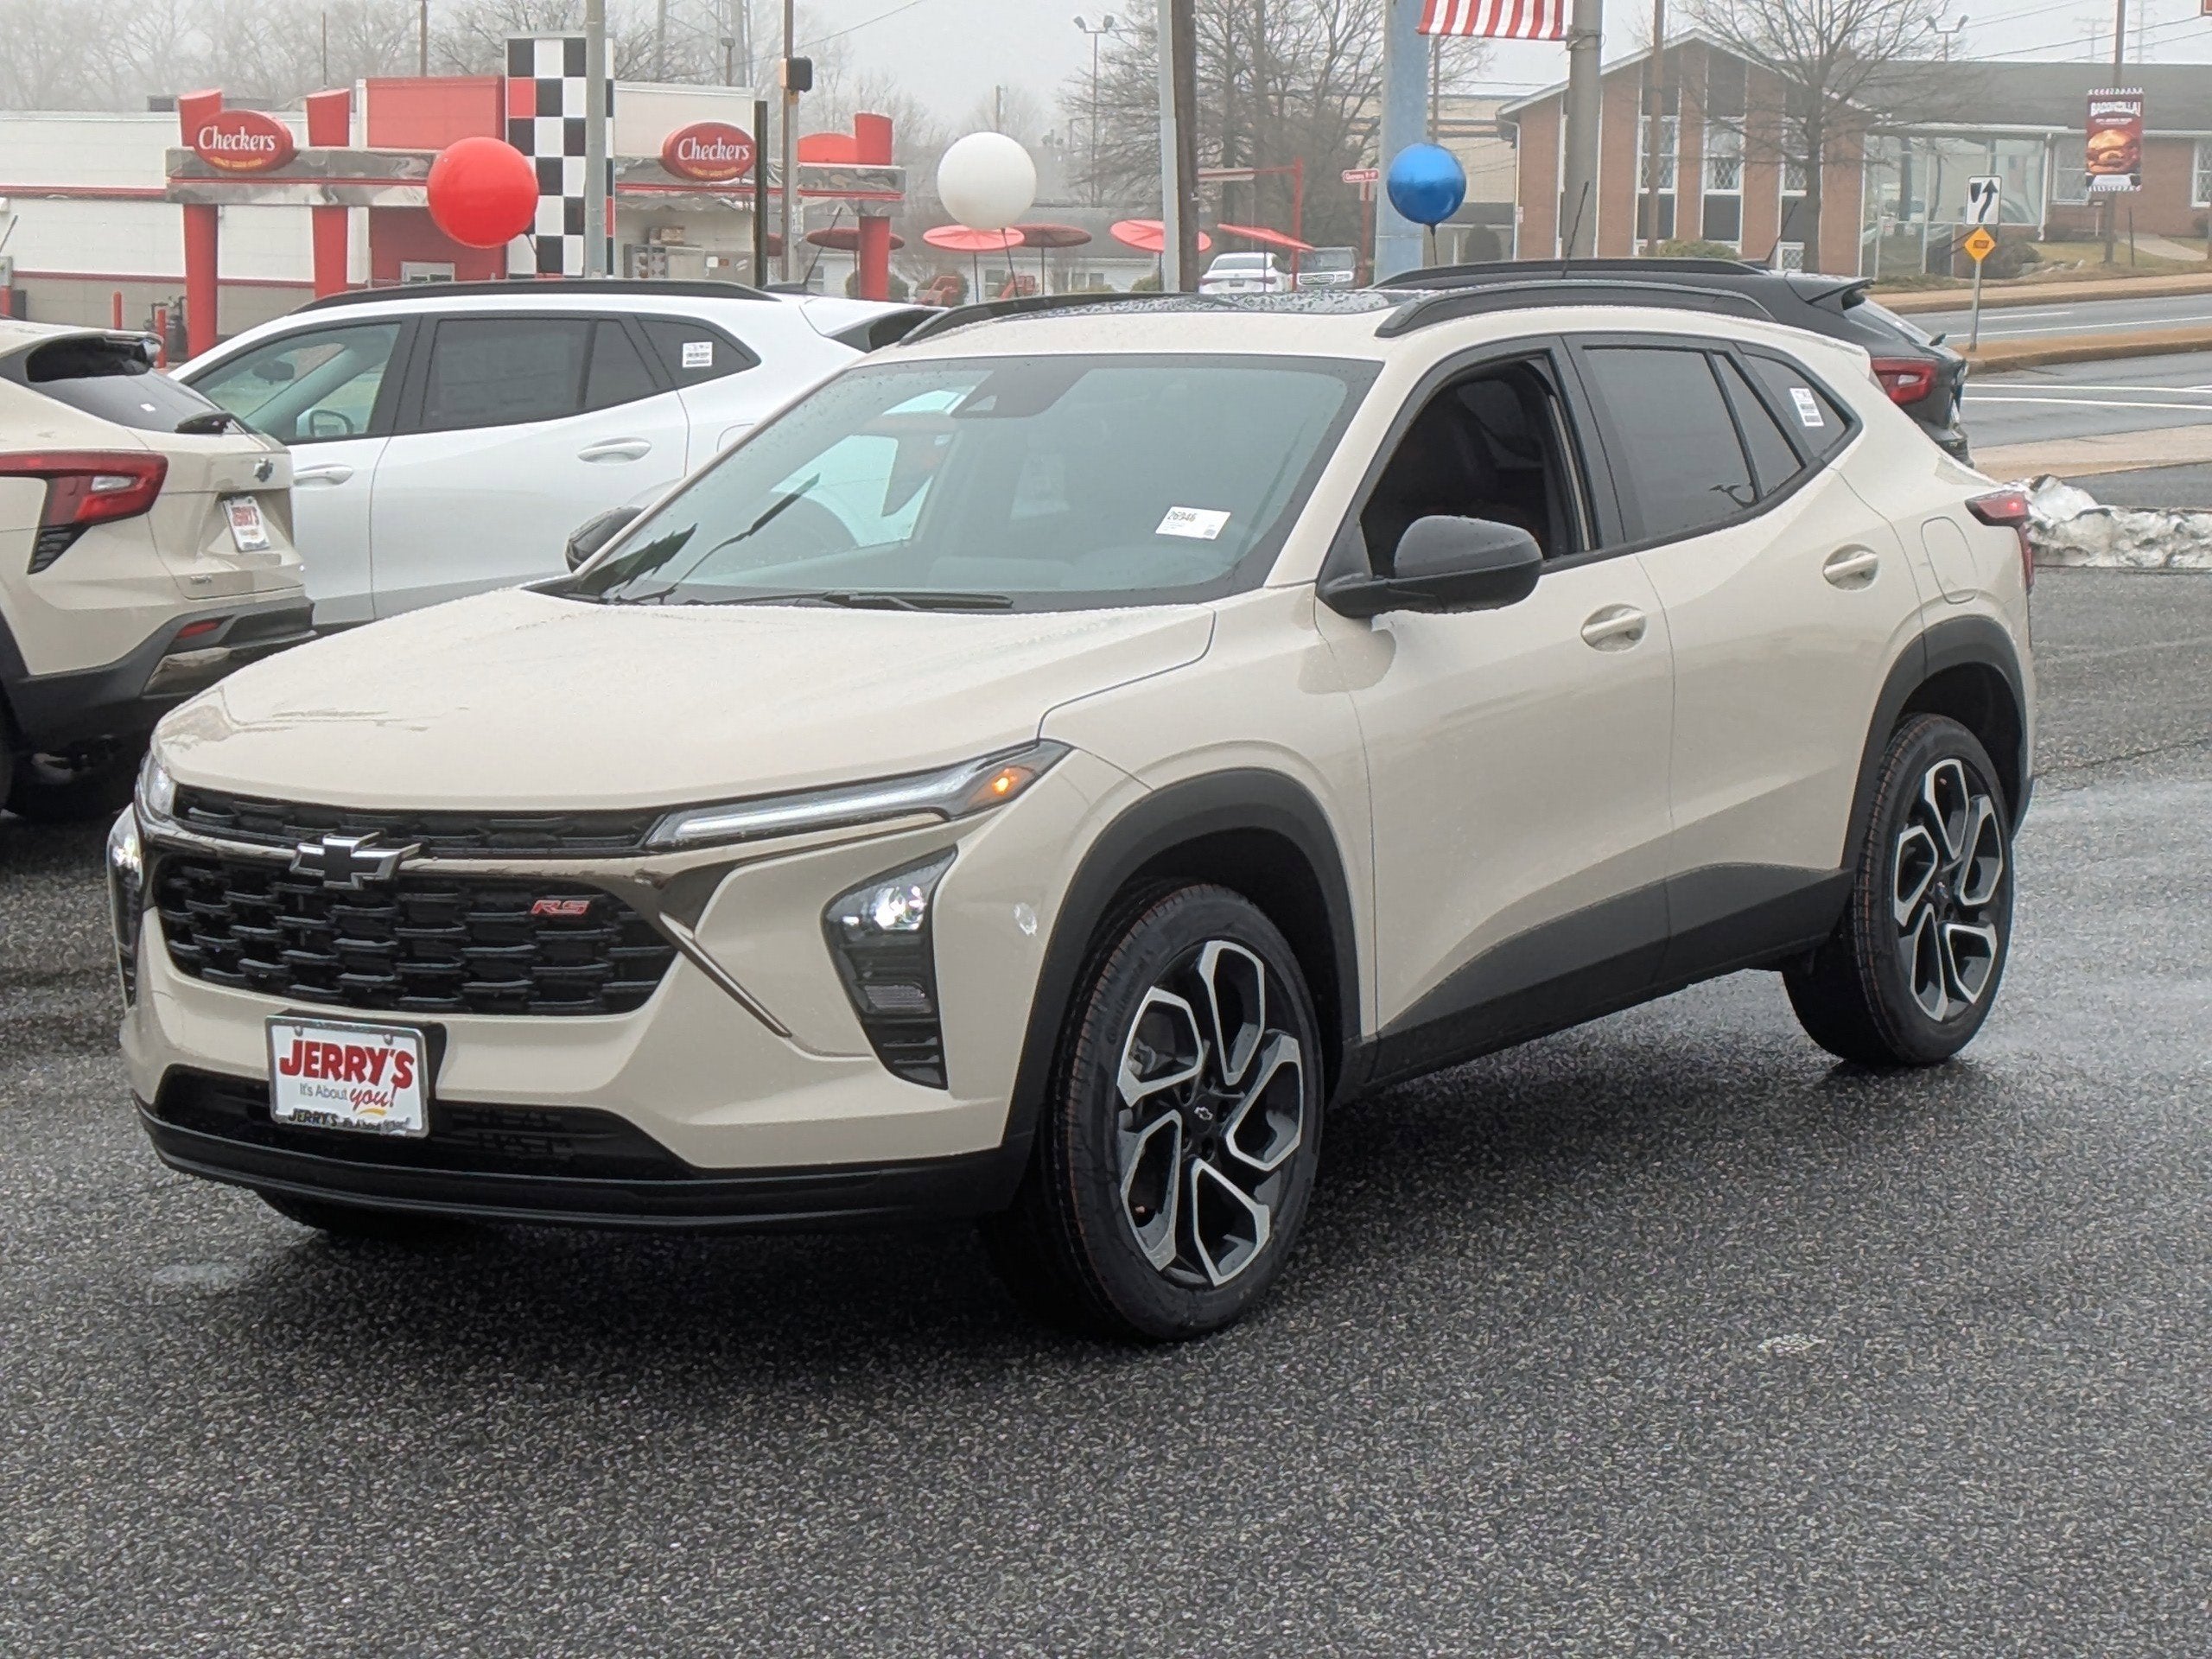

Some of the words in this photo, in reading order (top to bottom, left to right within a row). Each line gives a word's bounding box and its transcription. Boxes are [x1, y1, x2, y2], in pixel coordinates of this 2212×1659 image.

[198, 125, 276, 152] Checkers
[677, 137, 750, 161] Checkers
[530, 899, 590, 914] RS
[278, 1039, 415, 1090] JERRY'S
[299, 1082, 314, 1097] It's
[315, 1084, 347, 1101] About
[349, 1085, 398, 1112] you!
